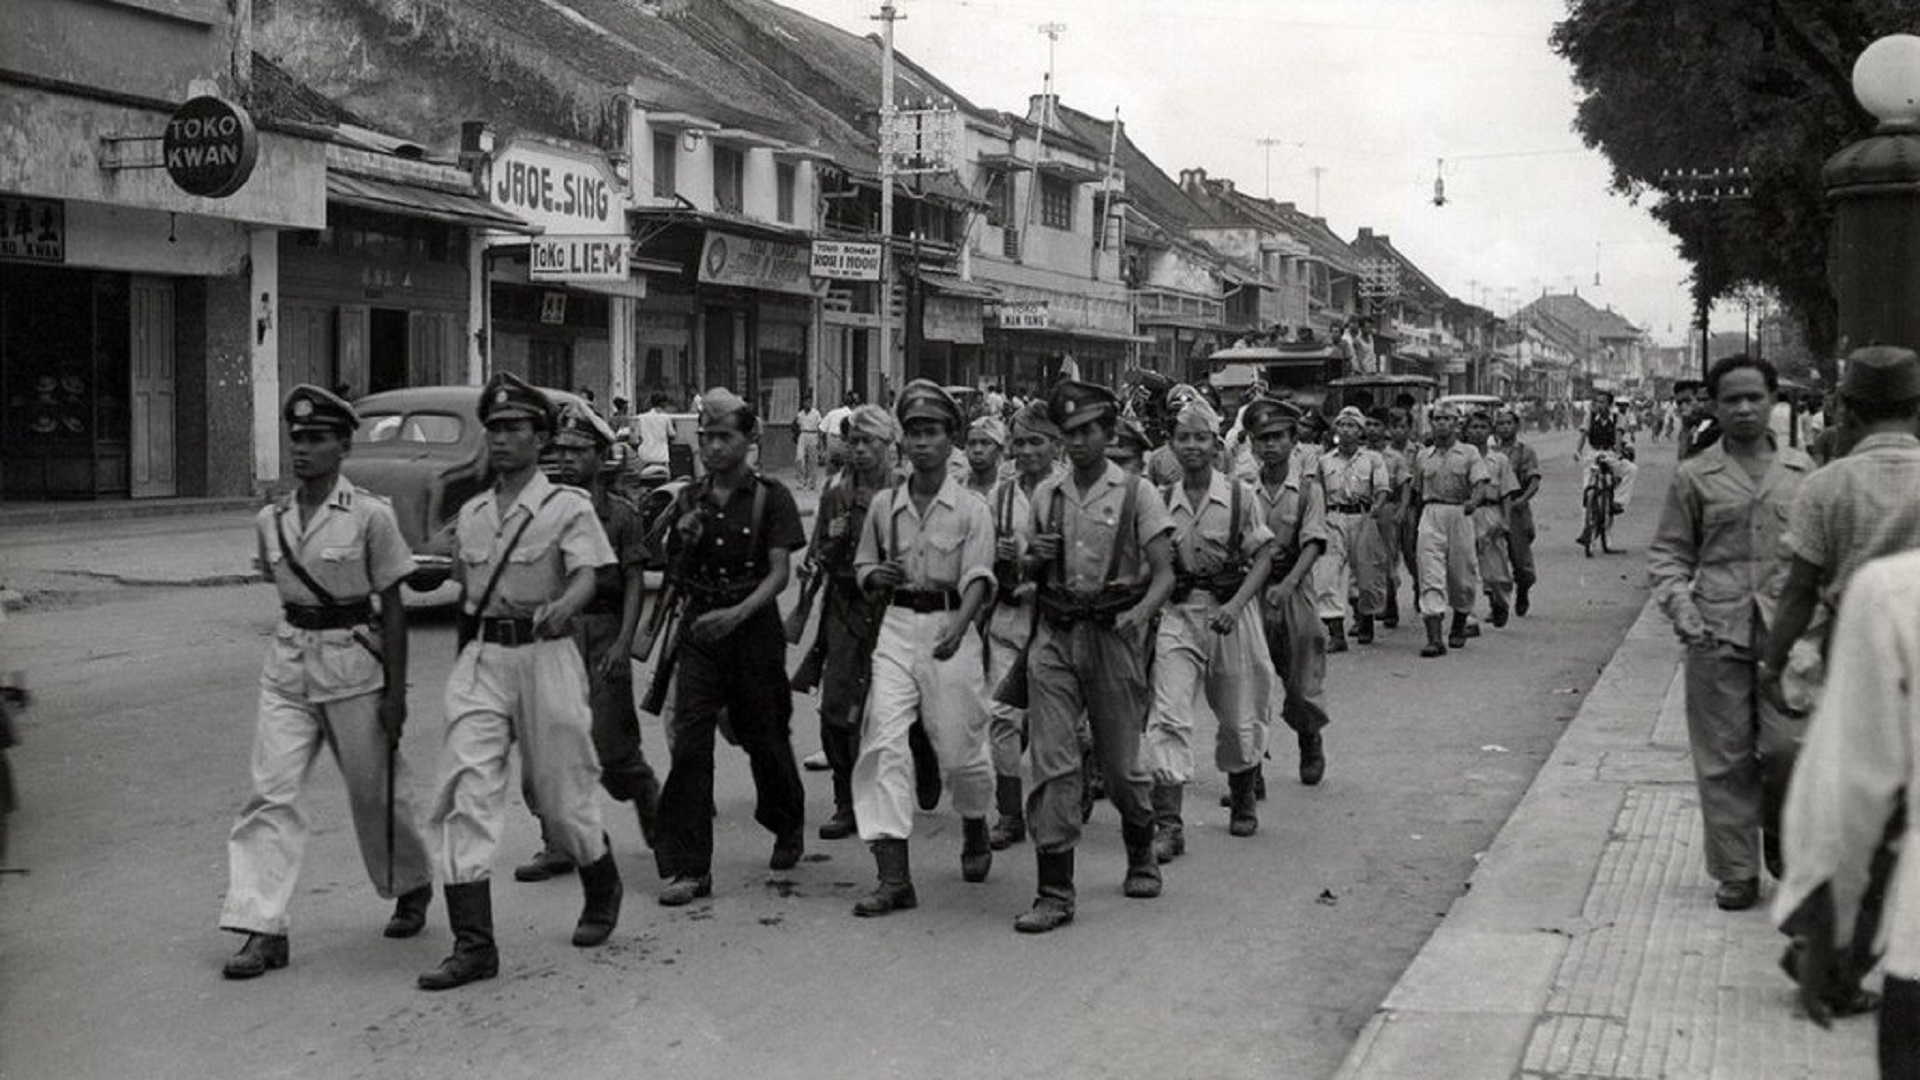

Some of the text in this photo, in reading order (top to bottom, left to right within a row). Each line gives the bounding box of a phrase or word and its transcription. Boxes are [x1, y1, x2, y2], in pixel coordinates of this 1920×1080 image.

[171, 115, 236, 138] TOKO
[167, 145, 238, 168] KWAN
[571, 242, 622, 274] LIEM
